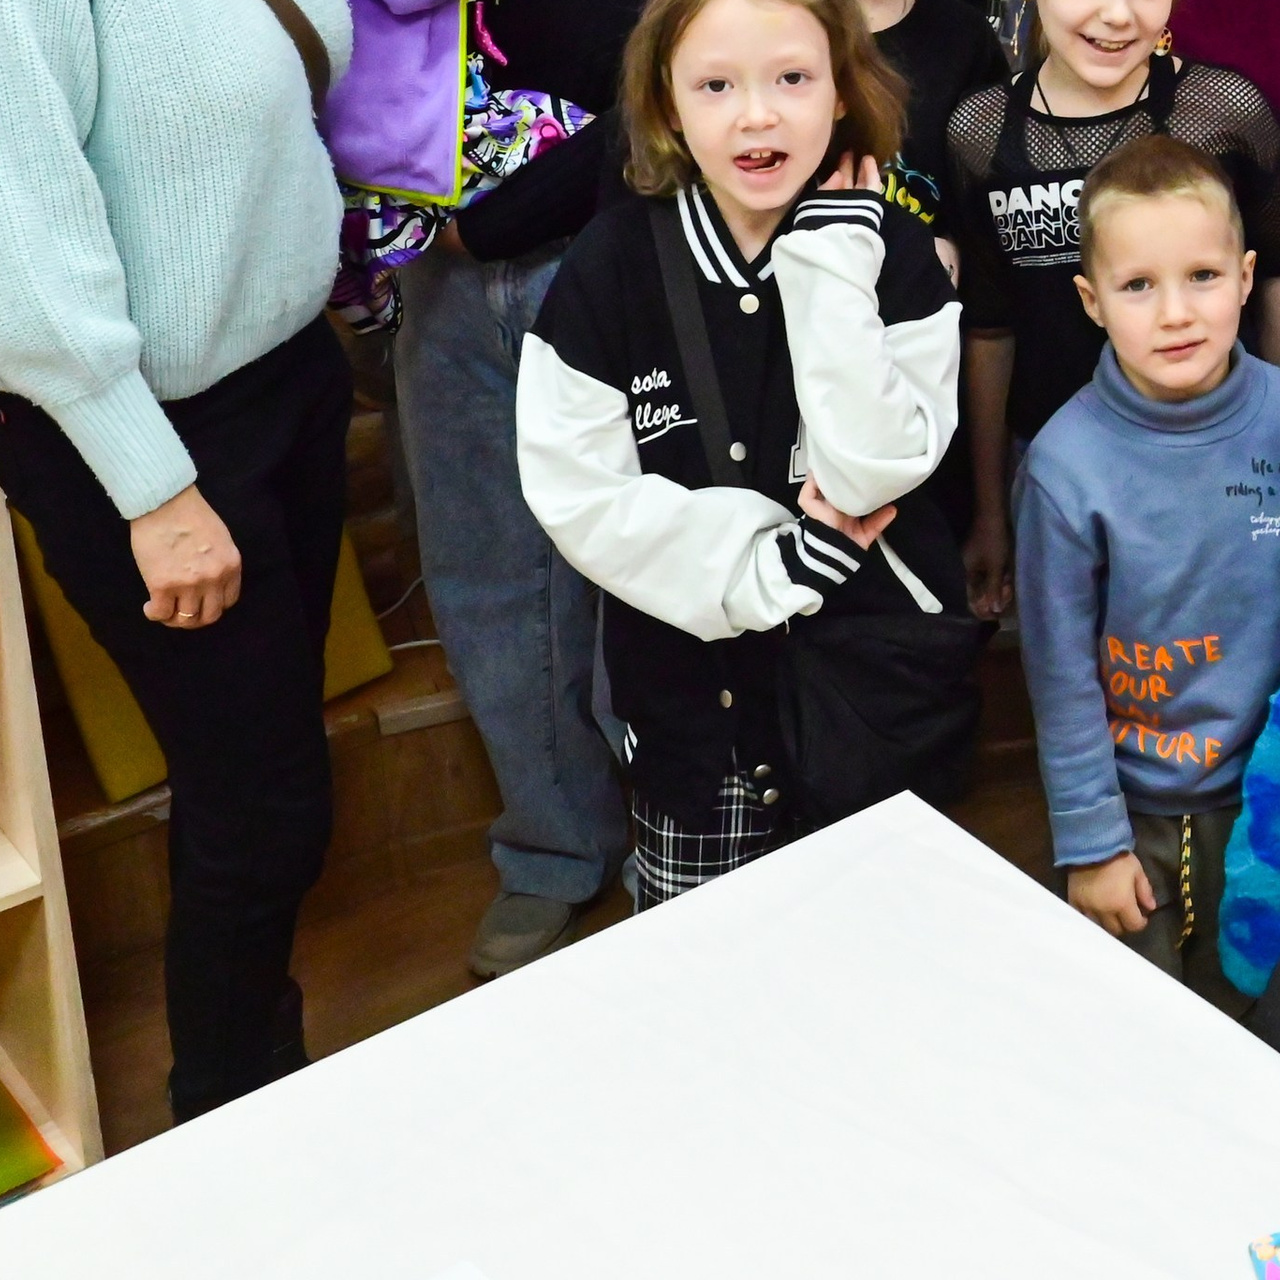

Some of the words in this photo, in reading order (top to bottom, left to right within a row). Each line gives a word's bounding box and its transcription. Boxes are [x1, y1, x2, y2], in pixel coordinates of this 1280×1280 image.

[1251, 458, 1274, 476] life
[1225, 482, 1263, 506] riding
[1268, 486, 1276, 496] a
[1107, 635, 1223, 671] REATE
